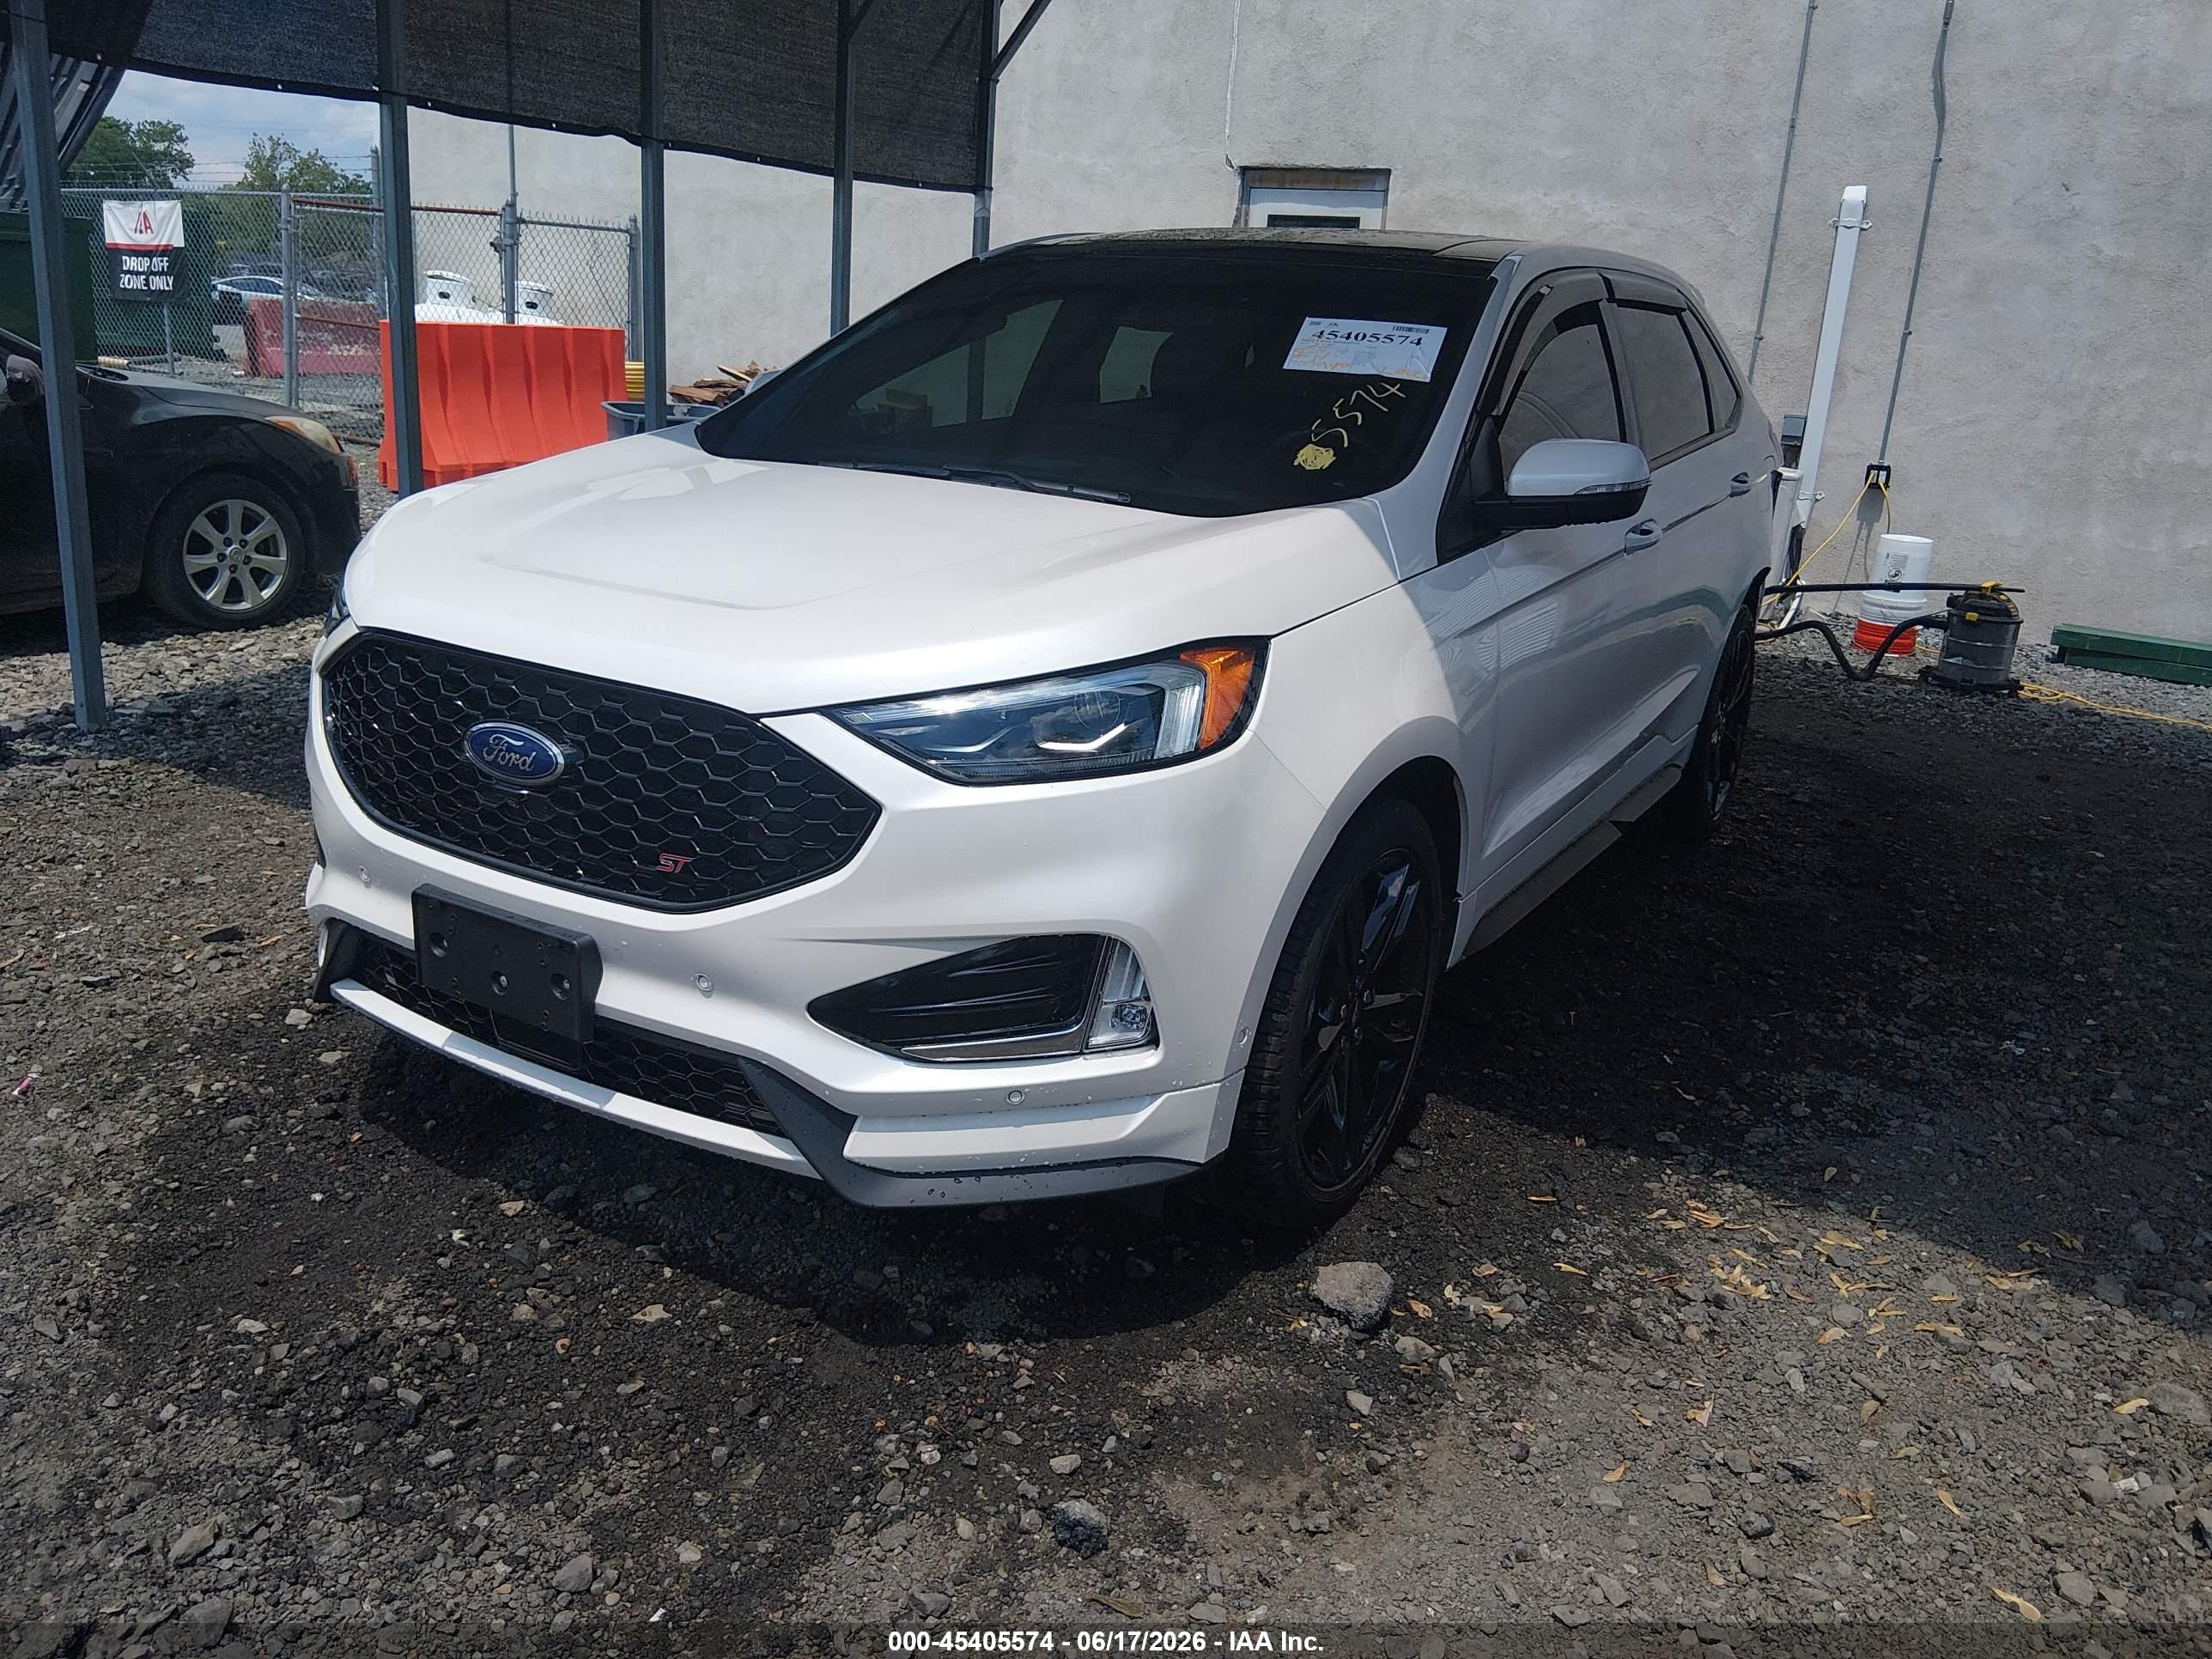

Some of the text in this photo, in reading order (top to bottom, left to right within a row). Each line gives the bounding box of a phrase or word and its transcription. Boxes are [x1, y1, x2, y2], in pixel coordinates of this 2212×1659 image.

[122, 256, 168, 271] DROP OFF
[120, 274, 173, 290] ZONE ONLY
[1311, 330, 1423, 346] 45405574
[483, 733, 536, 771] Ford
[657, 853, 694, 873] ST
